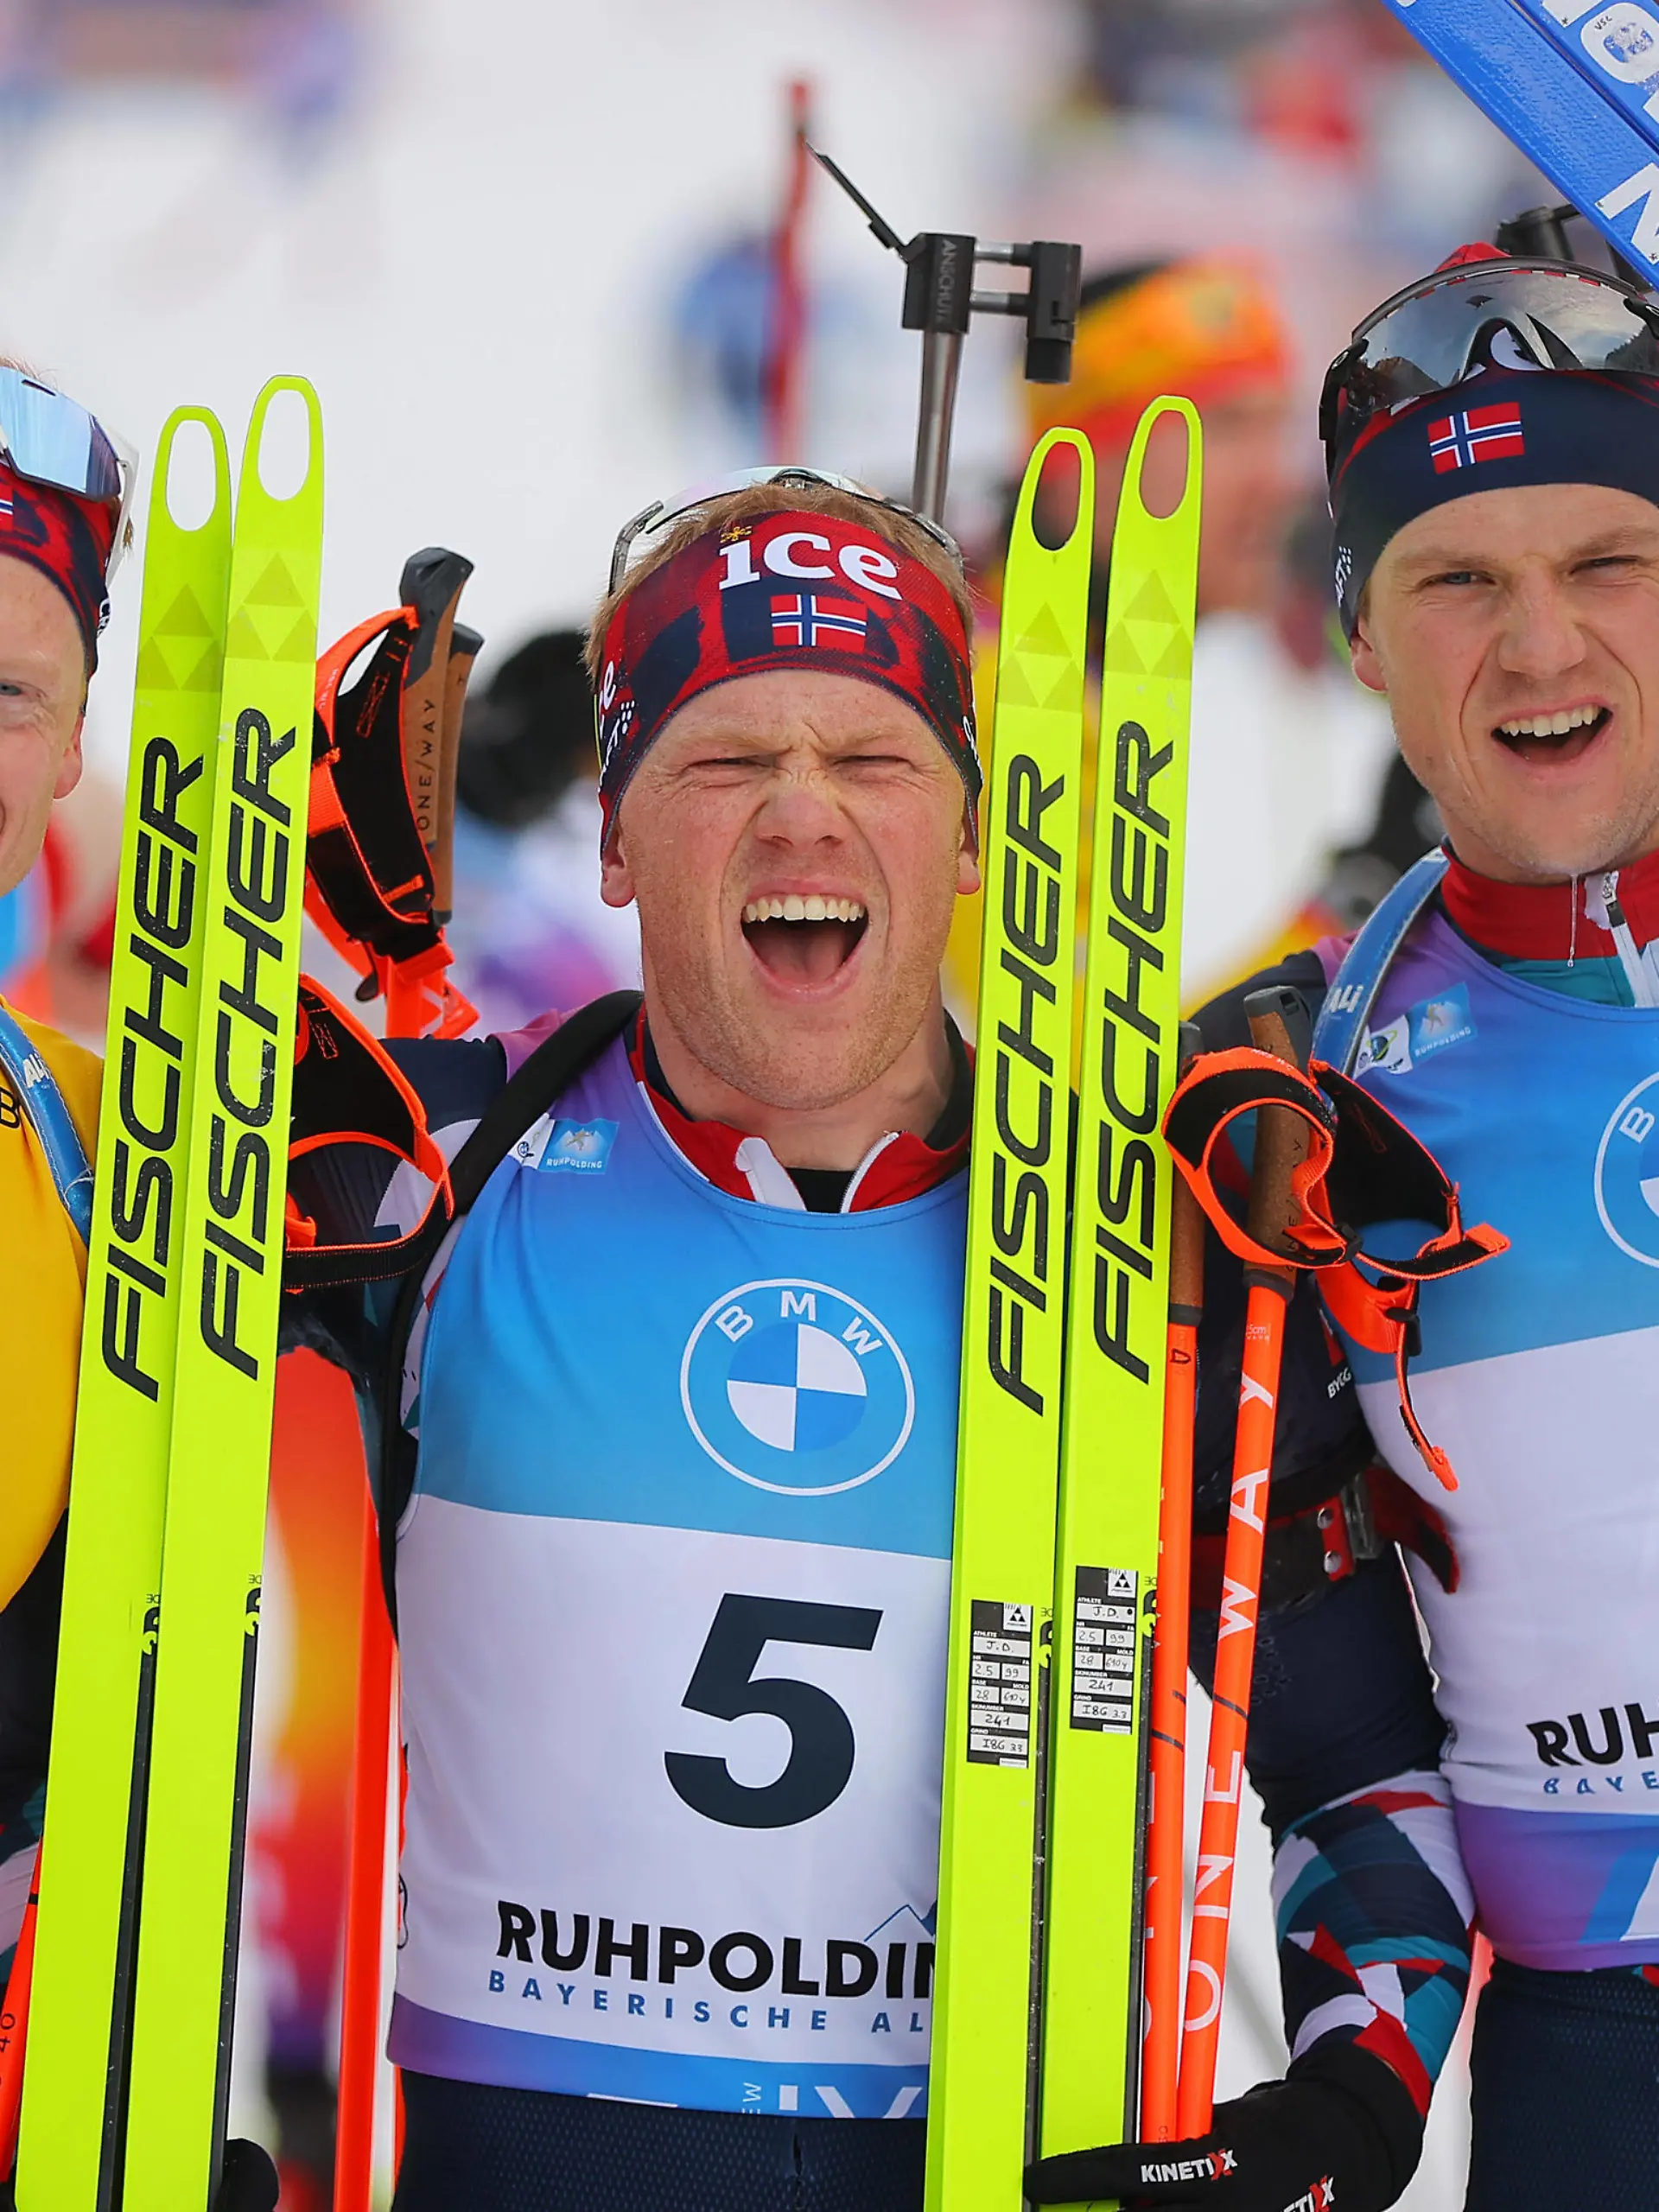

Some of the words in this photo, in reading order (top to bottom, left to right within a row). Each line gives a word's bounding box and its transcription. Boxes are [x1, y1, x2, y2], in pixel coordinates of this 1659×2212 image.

[718, 528, 903, 601] ice
[102, 736, 204, 1402] FISCHER
[200, 707, 296, 1381] FISCHER
[988, 753, 1065, 1416] FISCHER
[1094, 720, 1173, 1384] FISCHER
[715, 1290, 883, 1357] BMW
[664, 1592, 884, 1829] 5
[1526, 1702, 1659, 1767] RUH
[1543, 1770, 1659, 1795] BAYE
[495, 1899, 936, 2000] RUHPOLDI
[488, 1970, 827, 2031] BAYERISCHE
